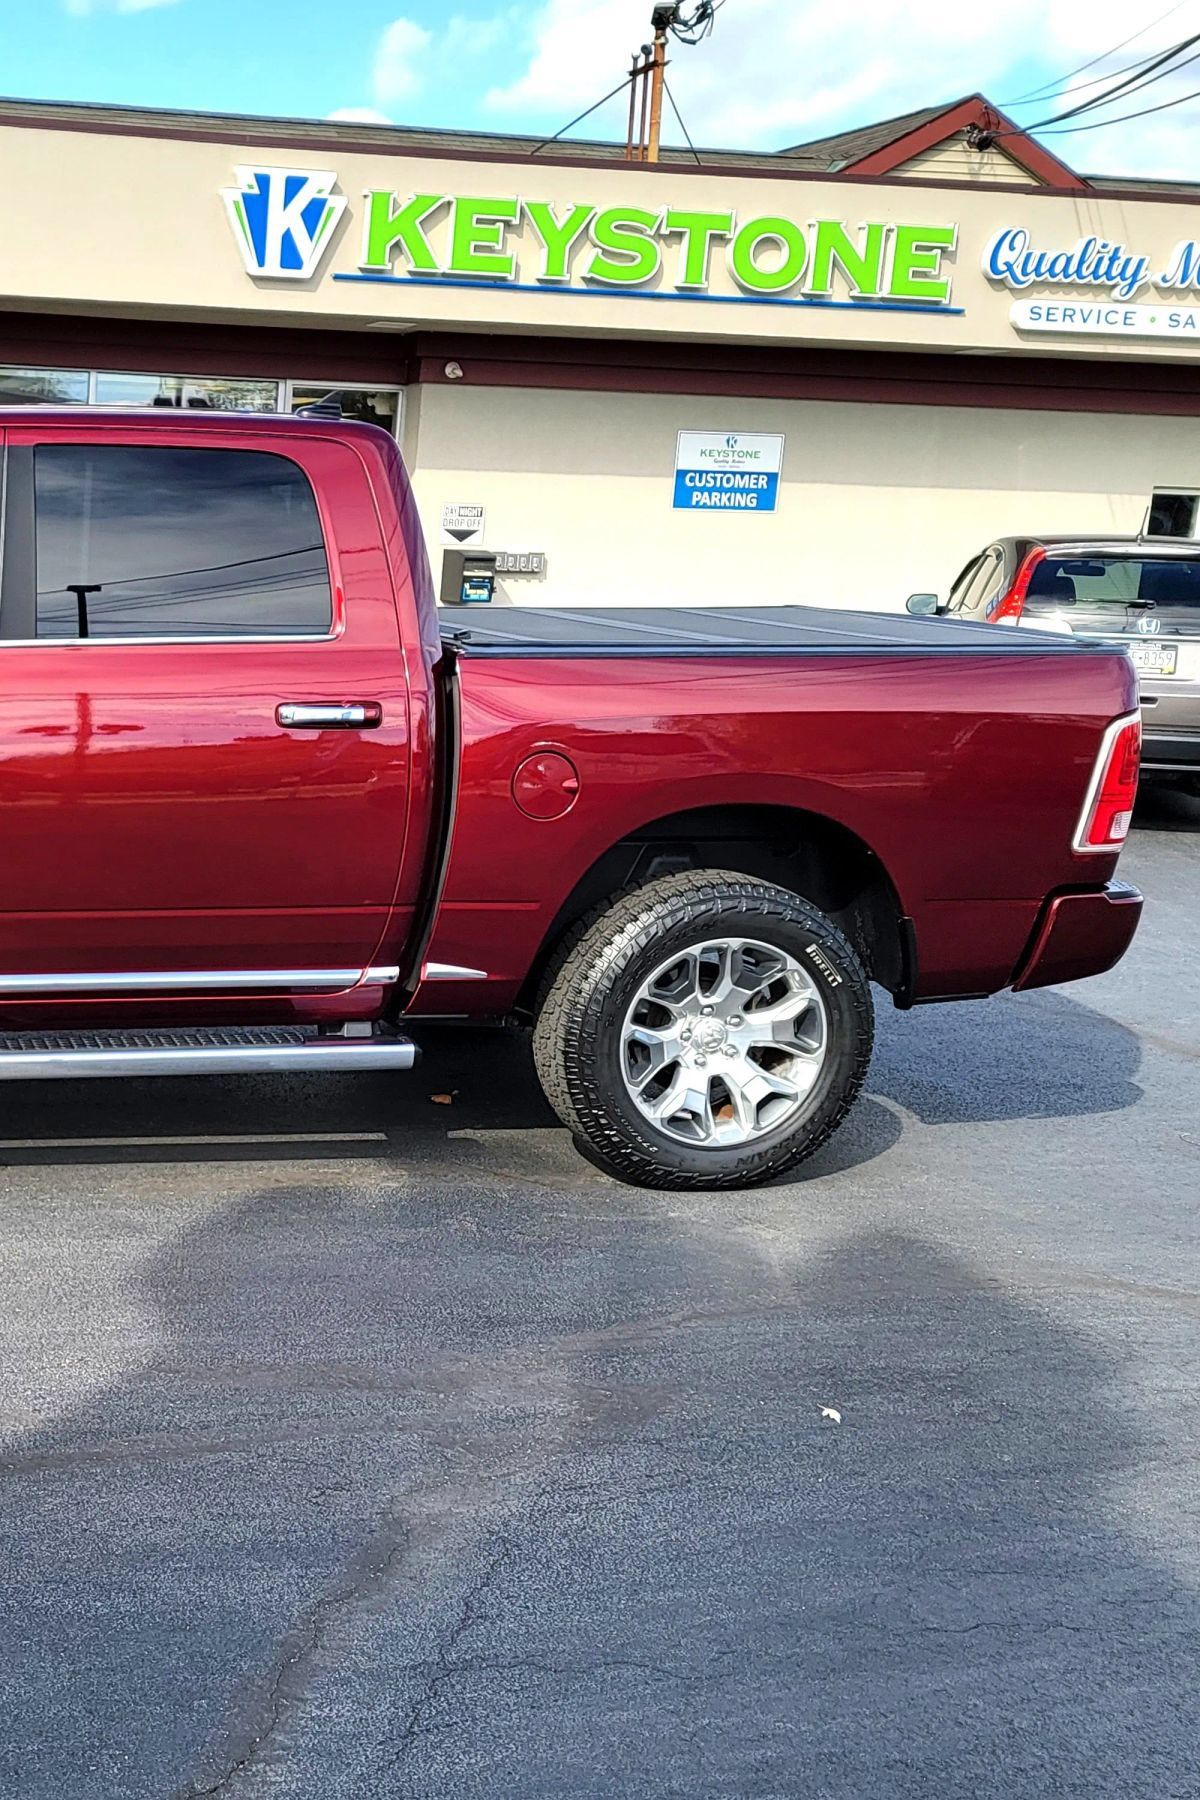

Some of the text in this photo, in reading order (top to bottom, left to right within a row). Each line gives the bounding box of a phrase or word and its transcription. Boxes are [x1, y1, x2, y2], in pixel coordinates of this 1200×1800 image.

[362, 189, 957, 302] KEYSTONE
[988, 229, 1147, 298] Quality
[1029, 305, 1136, 326] SERVICE
[700, 449, 761, 459] KEYSTONE
[685, 472, 768, 489] CUSTOMER
[691, 491, 758, 508] PARKING
[460, 506, 483, 517] NIGHT
[443, 518, 482, 528] DROP OFF
[805, 943, 843, 987] PIRELLI
